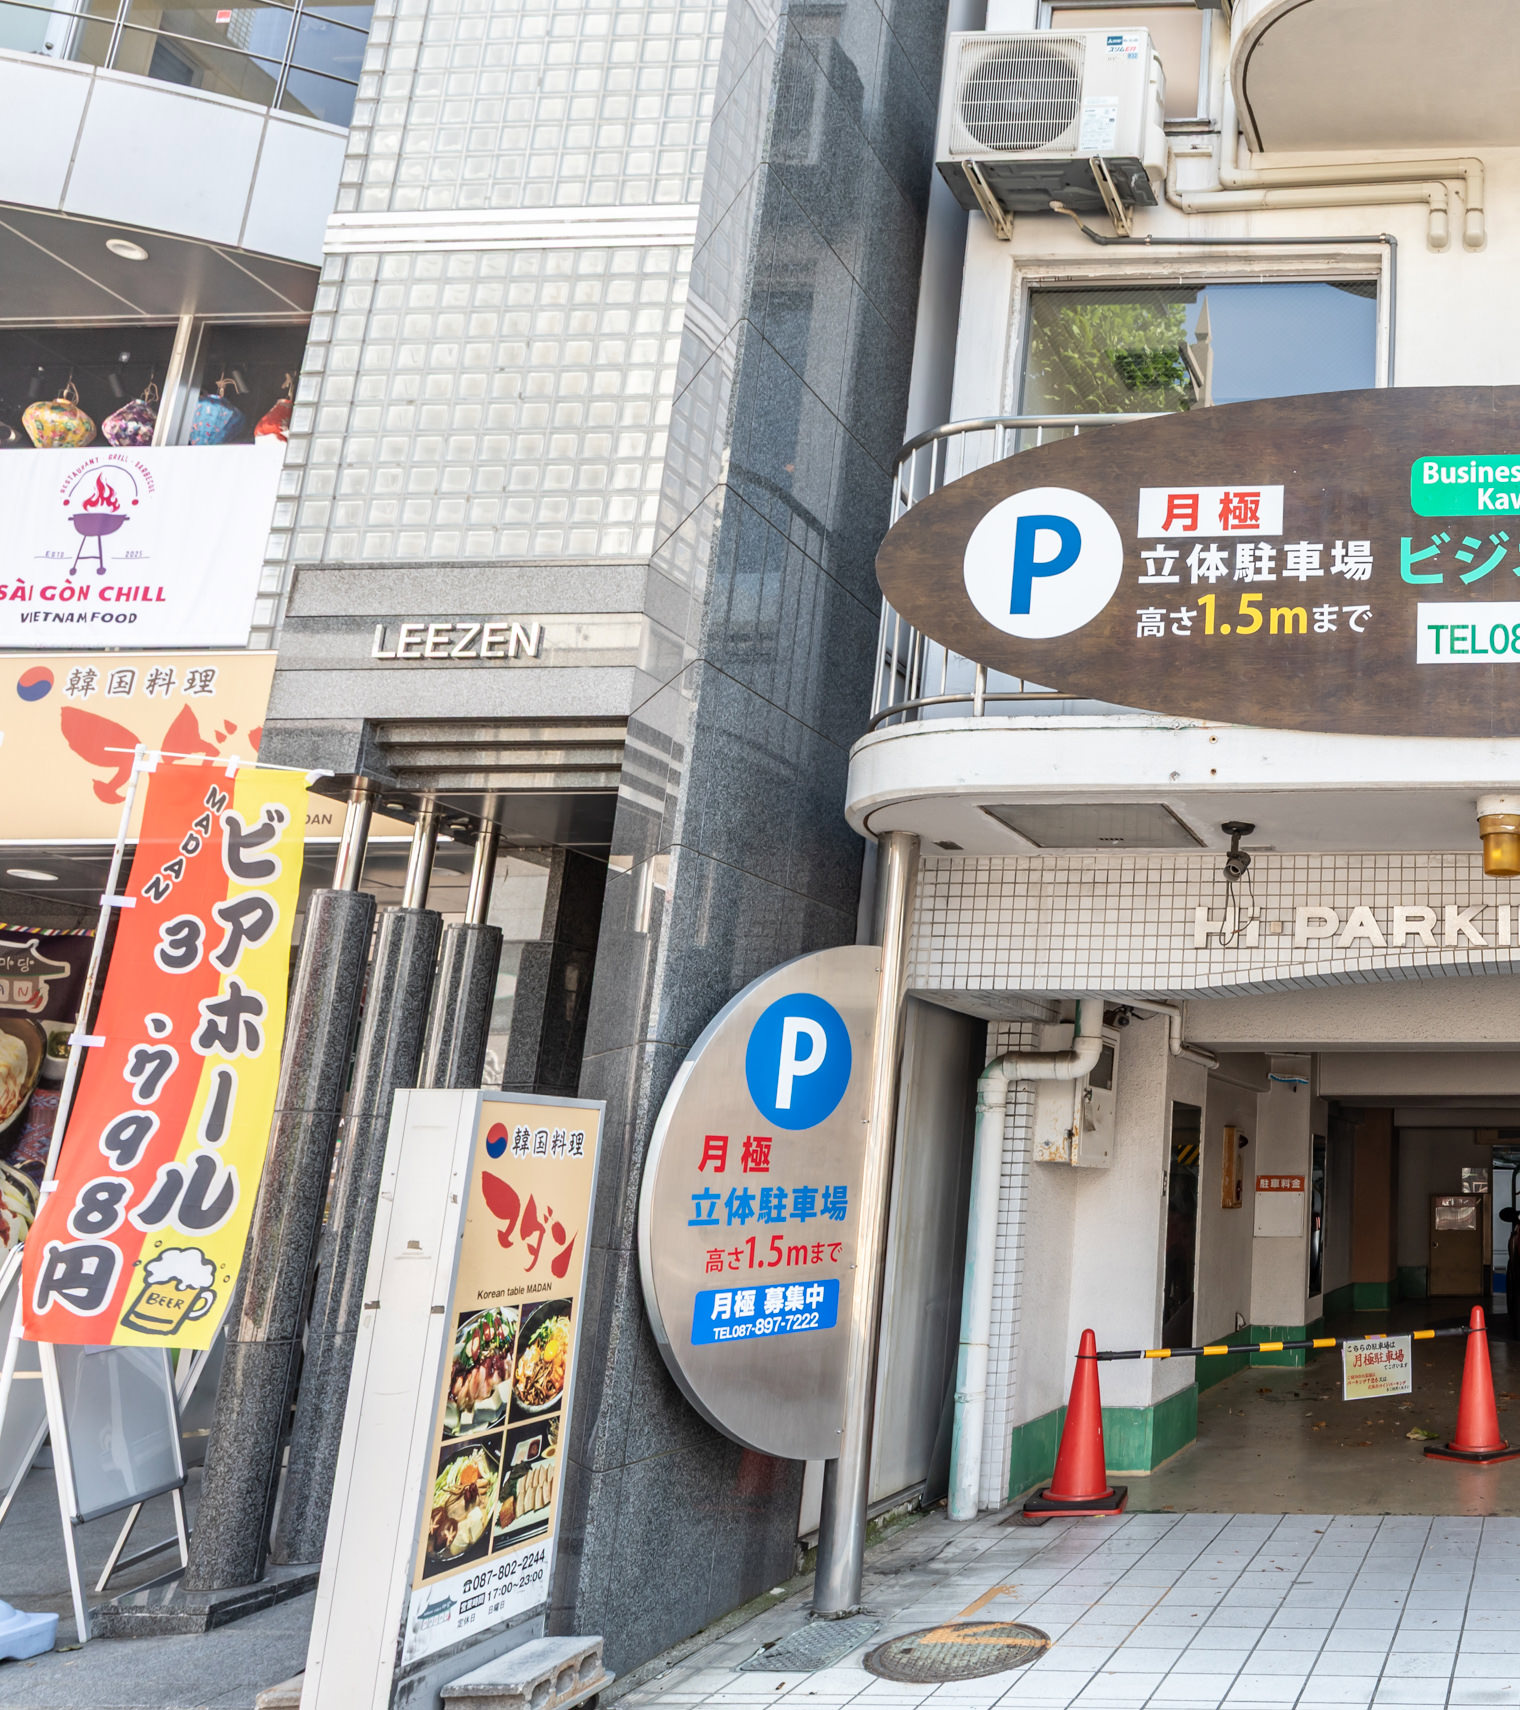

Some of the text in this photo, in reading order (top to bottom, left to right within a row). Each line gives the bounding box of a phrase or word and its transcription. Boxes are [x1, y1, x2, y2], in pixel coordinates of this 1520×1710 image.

[1161, 491, 1261, 533] 月極
[1010, 514, 1082, 615] P
[1138, 540, 1374, 584] 立体駐車場
[0, 578, 166, 602] SÀI GÒN CHILL
[20, 611, 138, 623] VIETNAM FOOD
[371, 621, 543, 660] LEEZEN
[65, 667, 217, 697] 韓国料理
[143, 786, 228, 902] MADAN
[136, 807, 286, 1231] ビアホール
[775, 1016, 827, 1109] P
[512, 1129, 584, 1157] 韓国料理
[698, 1135, 773, 1174] 月極
[1259, 1178, 1301, 1188] 駐車料金
[481, 1170, 578, 1279] マダン
[687, 1185, 849, 1228] 立体駐車場
[146, 1291, 185, 1309] BEER
[477, 1282, 552, 1300] Korean table MADAN
[711, 1283, 824, 1321] 月極 募集中
[1353, 1348, 1404, 1368] 月極駐車場
